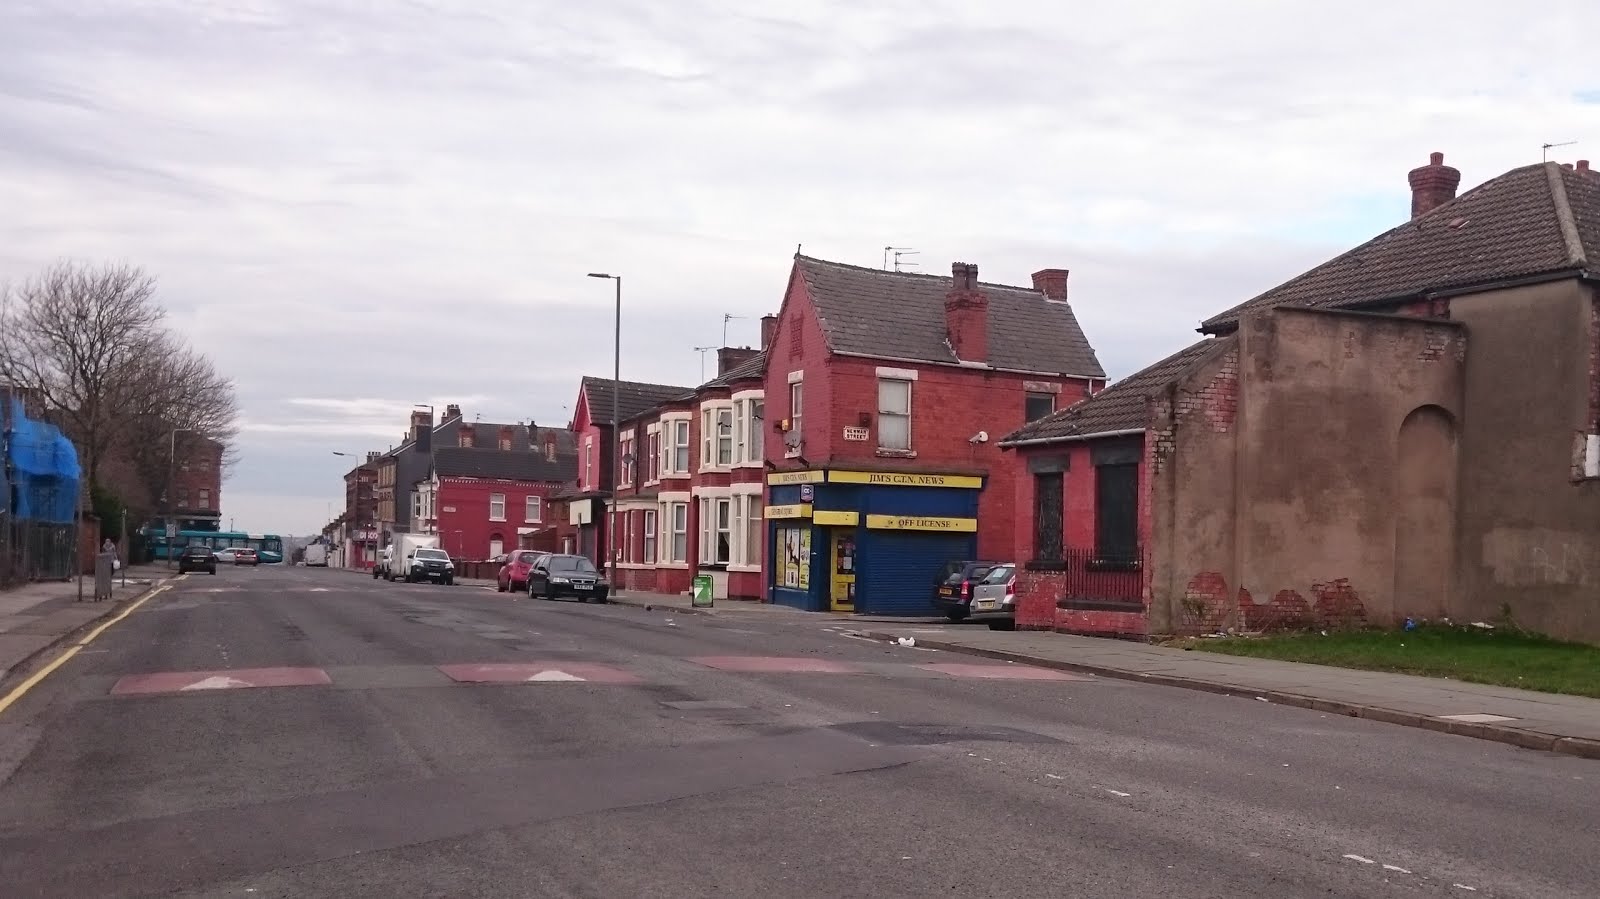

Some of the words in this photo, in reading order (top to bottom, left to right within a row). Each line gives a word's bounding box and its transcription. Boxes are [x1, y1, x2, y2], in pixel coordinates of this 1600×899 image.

[869, 474, 891, 483] JIM'S
[893, 475, 916, 484] C.T.N.
[918, 476, 944, 485] NEWS
[898, 519, 914, 527] OFF
[916, 520, 951, 528] LICENSE
